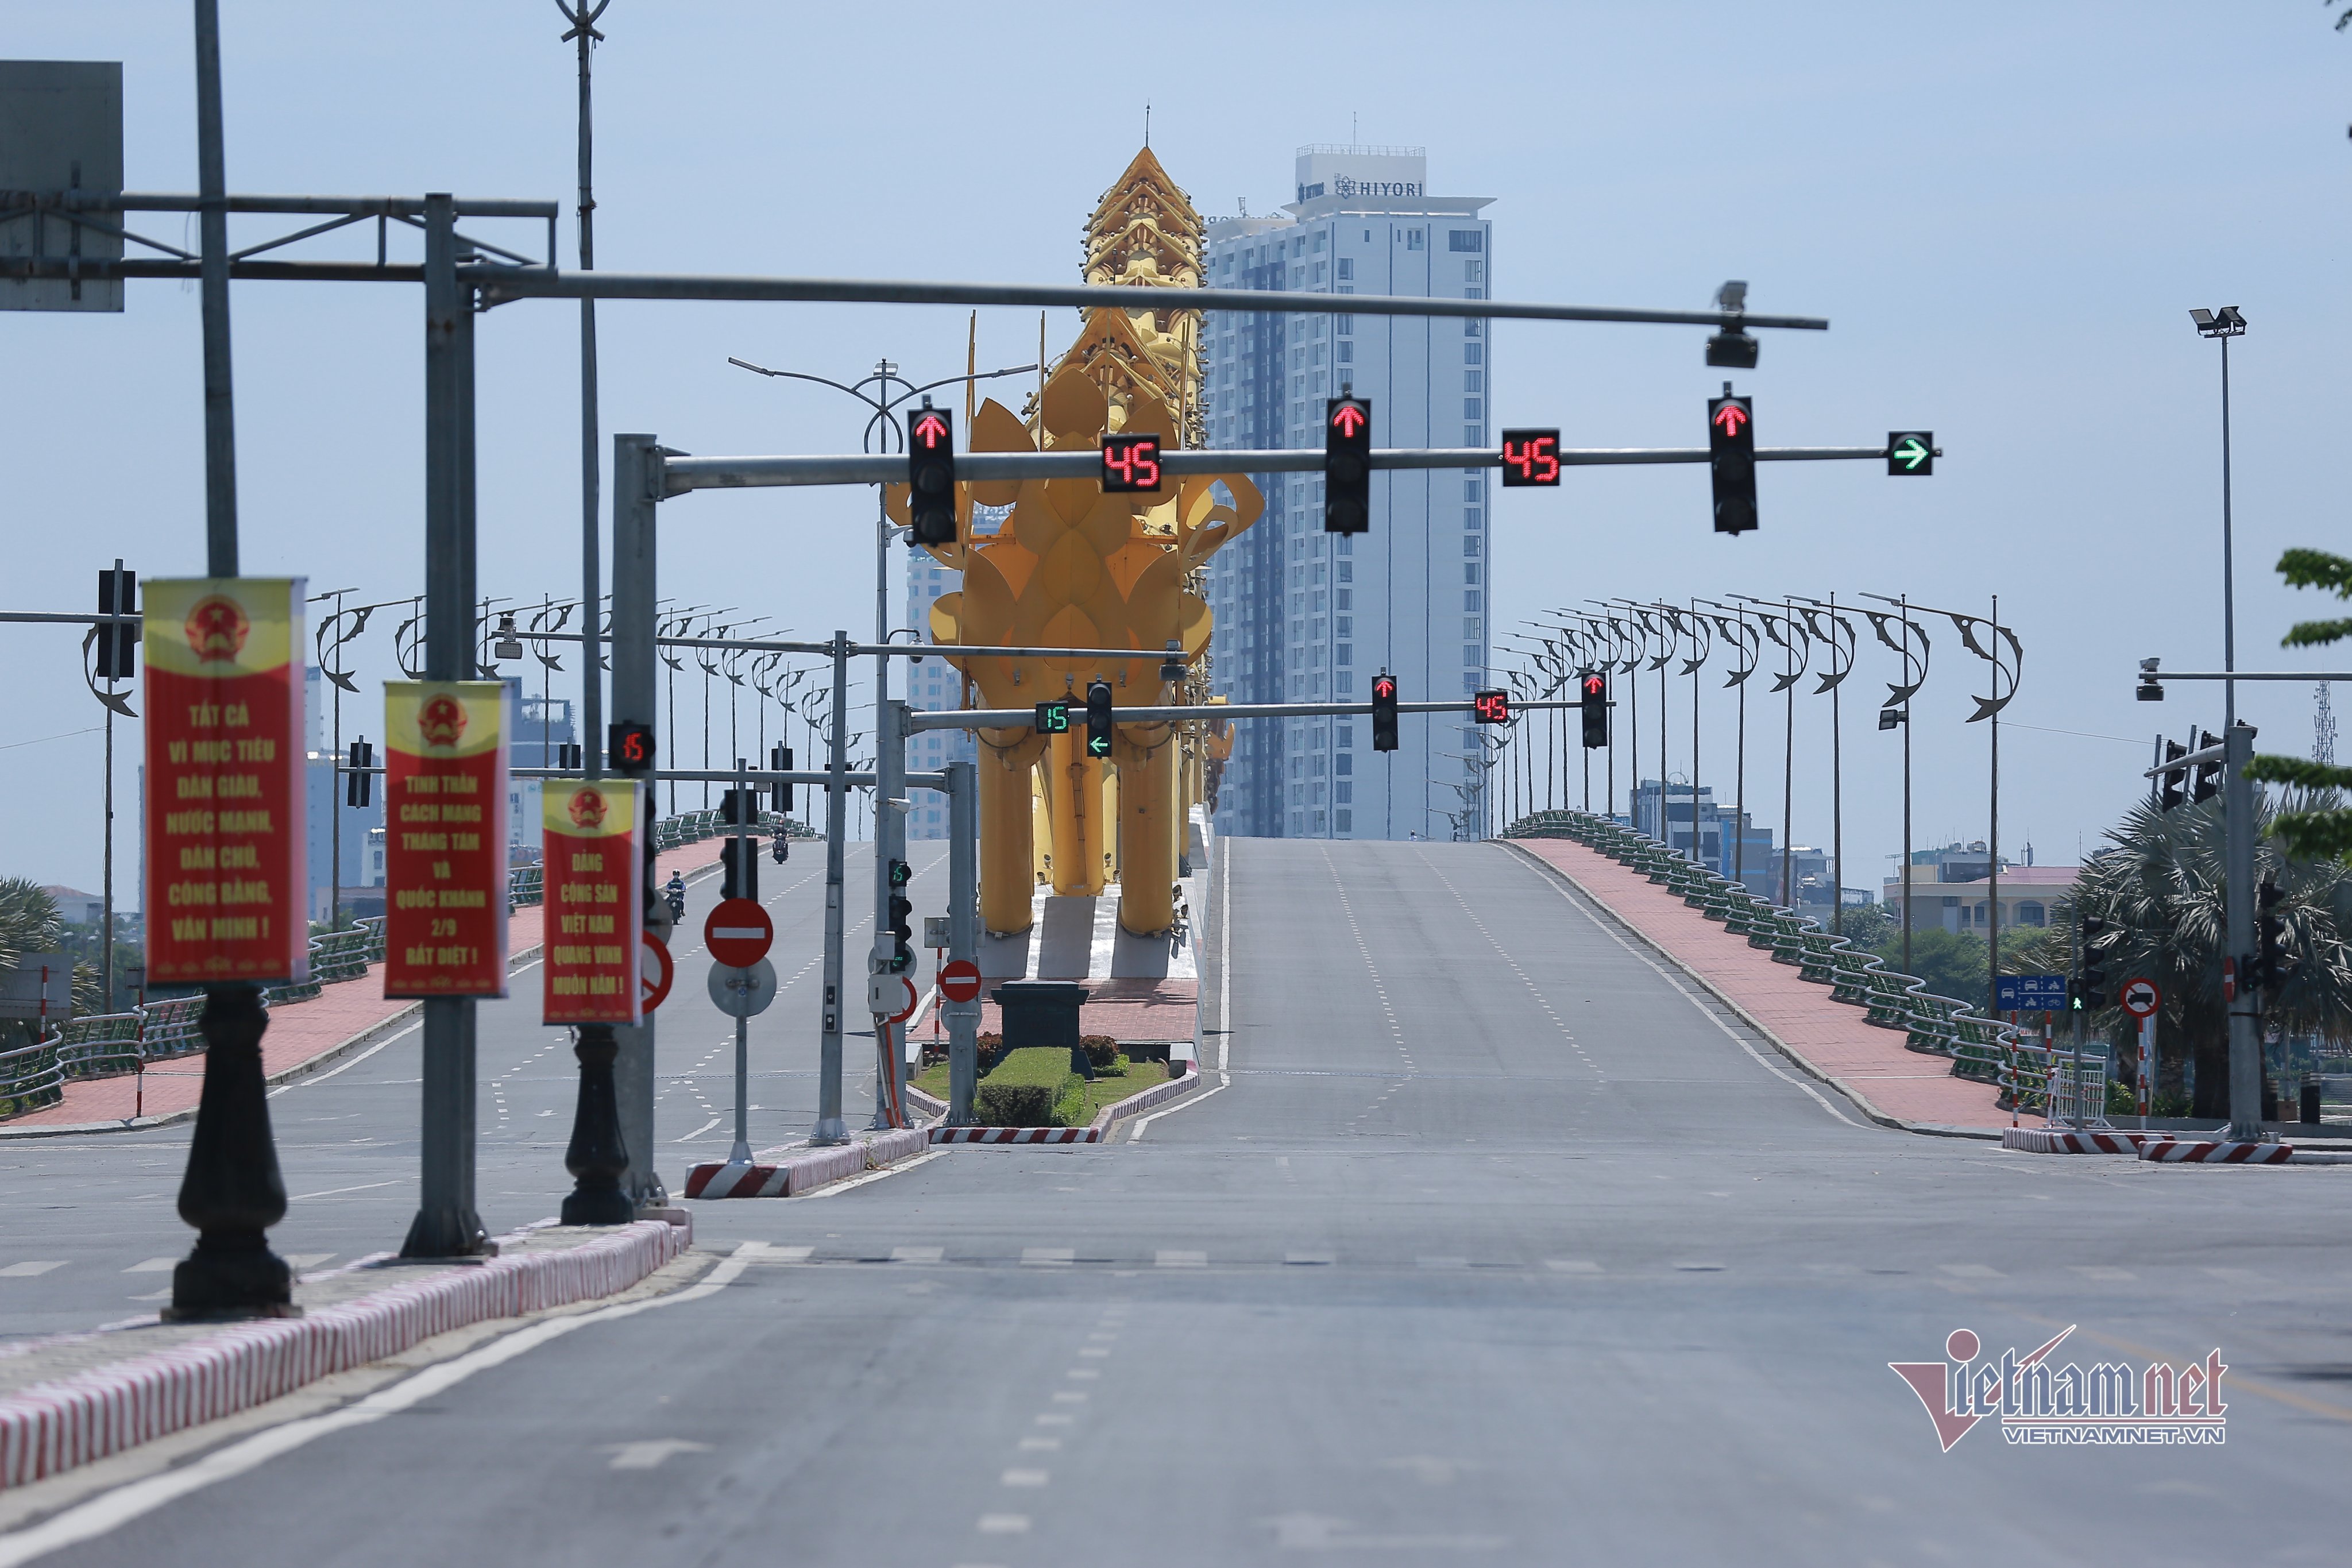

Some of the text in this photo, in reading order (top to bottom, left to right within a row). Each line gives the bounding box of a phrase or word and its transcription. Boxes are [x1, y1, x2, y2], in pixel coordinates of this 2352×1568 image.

[1361, 182, 1422, 196] HIYORI
[1105, 442, 1158, 486] 45
[1504, 437, 1558, 481] 45
[1048, 706, 1067, 730] 15
[1477, 696, 1506, 720] 45
[212, 917, 256, 940] MINH
[432, 918, 456, 936] 2/9
